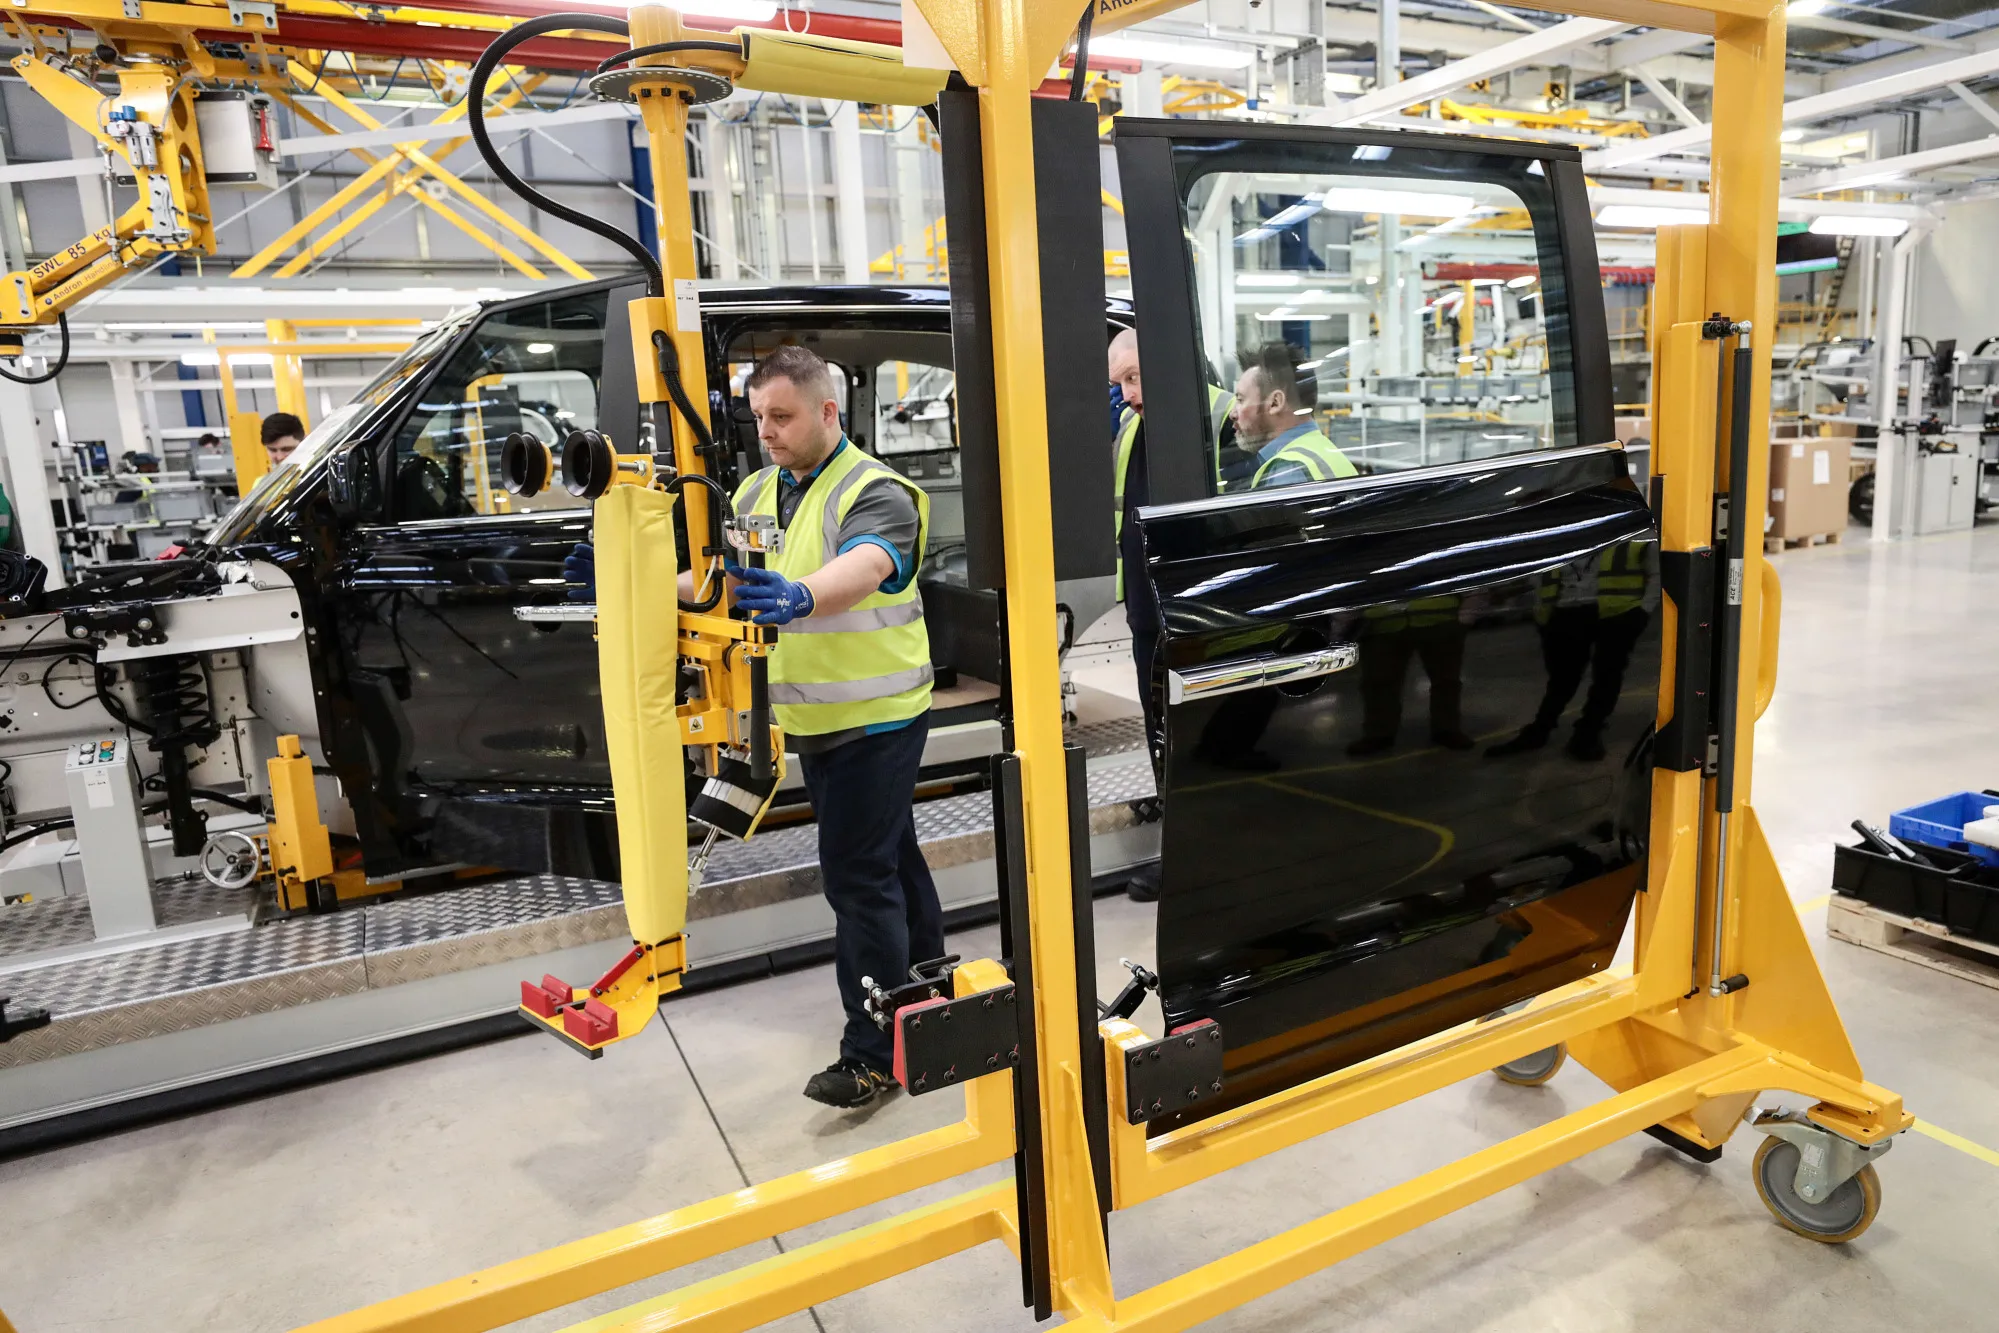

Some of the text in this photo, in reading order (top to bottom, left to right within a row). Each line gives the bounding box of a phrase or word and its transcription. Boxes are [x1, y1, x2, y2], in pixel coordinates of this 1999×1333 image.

[33, 257, 64, 279] SWL
[67, 242, 87, 260] 85
[53, 280, 83, 300] Andron
